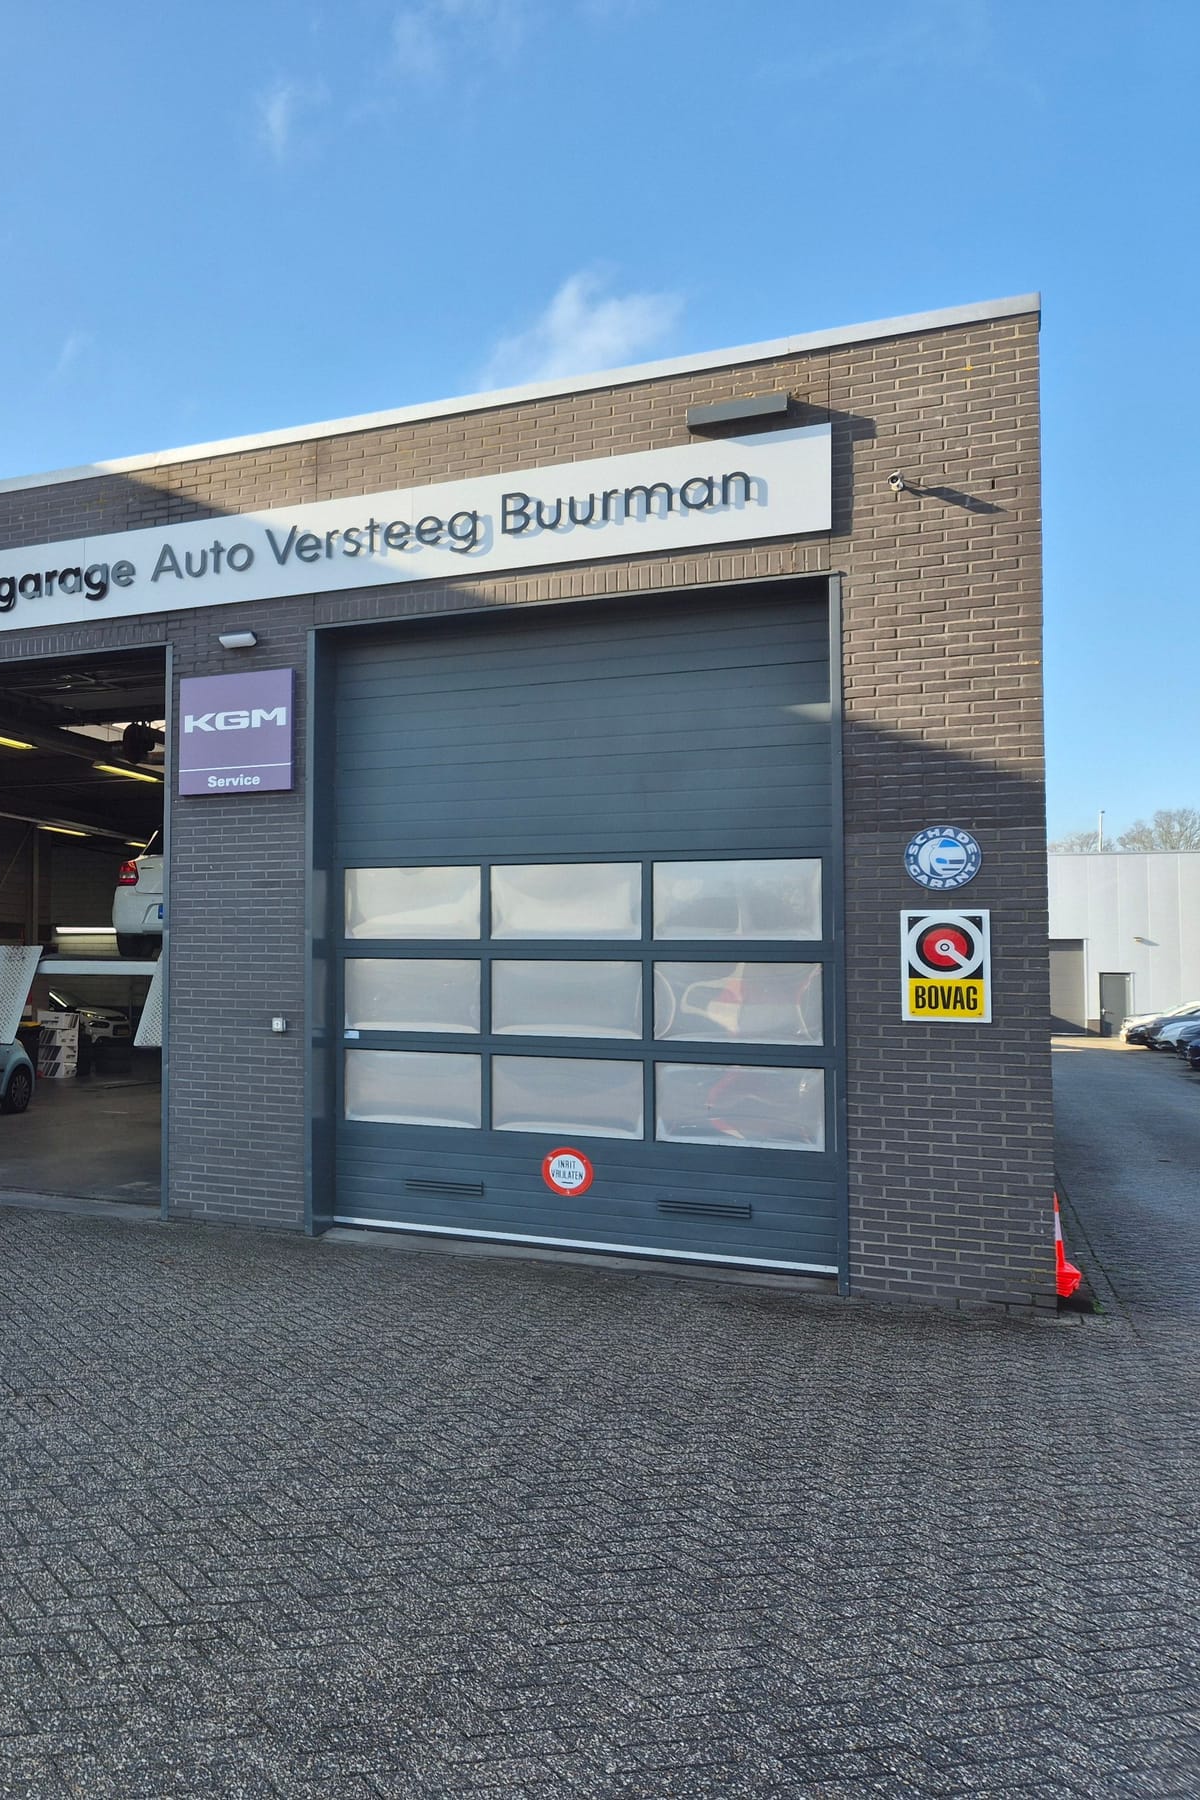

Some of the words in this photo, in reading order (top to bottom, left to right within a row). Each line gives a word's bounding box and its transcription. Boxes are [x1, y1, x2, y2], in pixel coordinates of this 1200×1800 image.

[151, 540, 254, 582] Auto
[265, 510, 478, 565] Versteeg
[501, 471, 751, 534] Buurman
[184, 707, 287, 733] KGM
[207, 774, 260, 788] Service
[908, 828, 978, 855] SCHADE
[909, 862, 976, 888] GARANT
[914, 985, 978, 1010] BOVAG
[557, 1160, 576, 1169] INRIT
